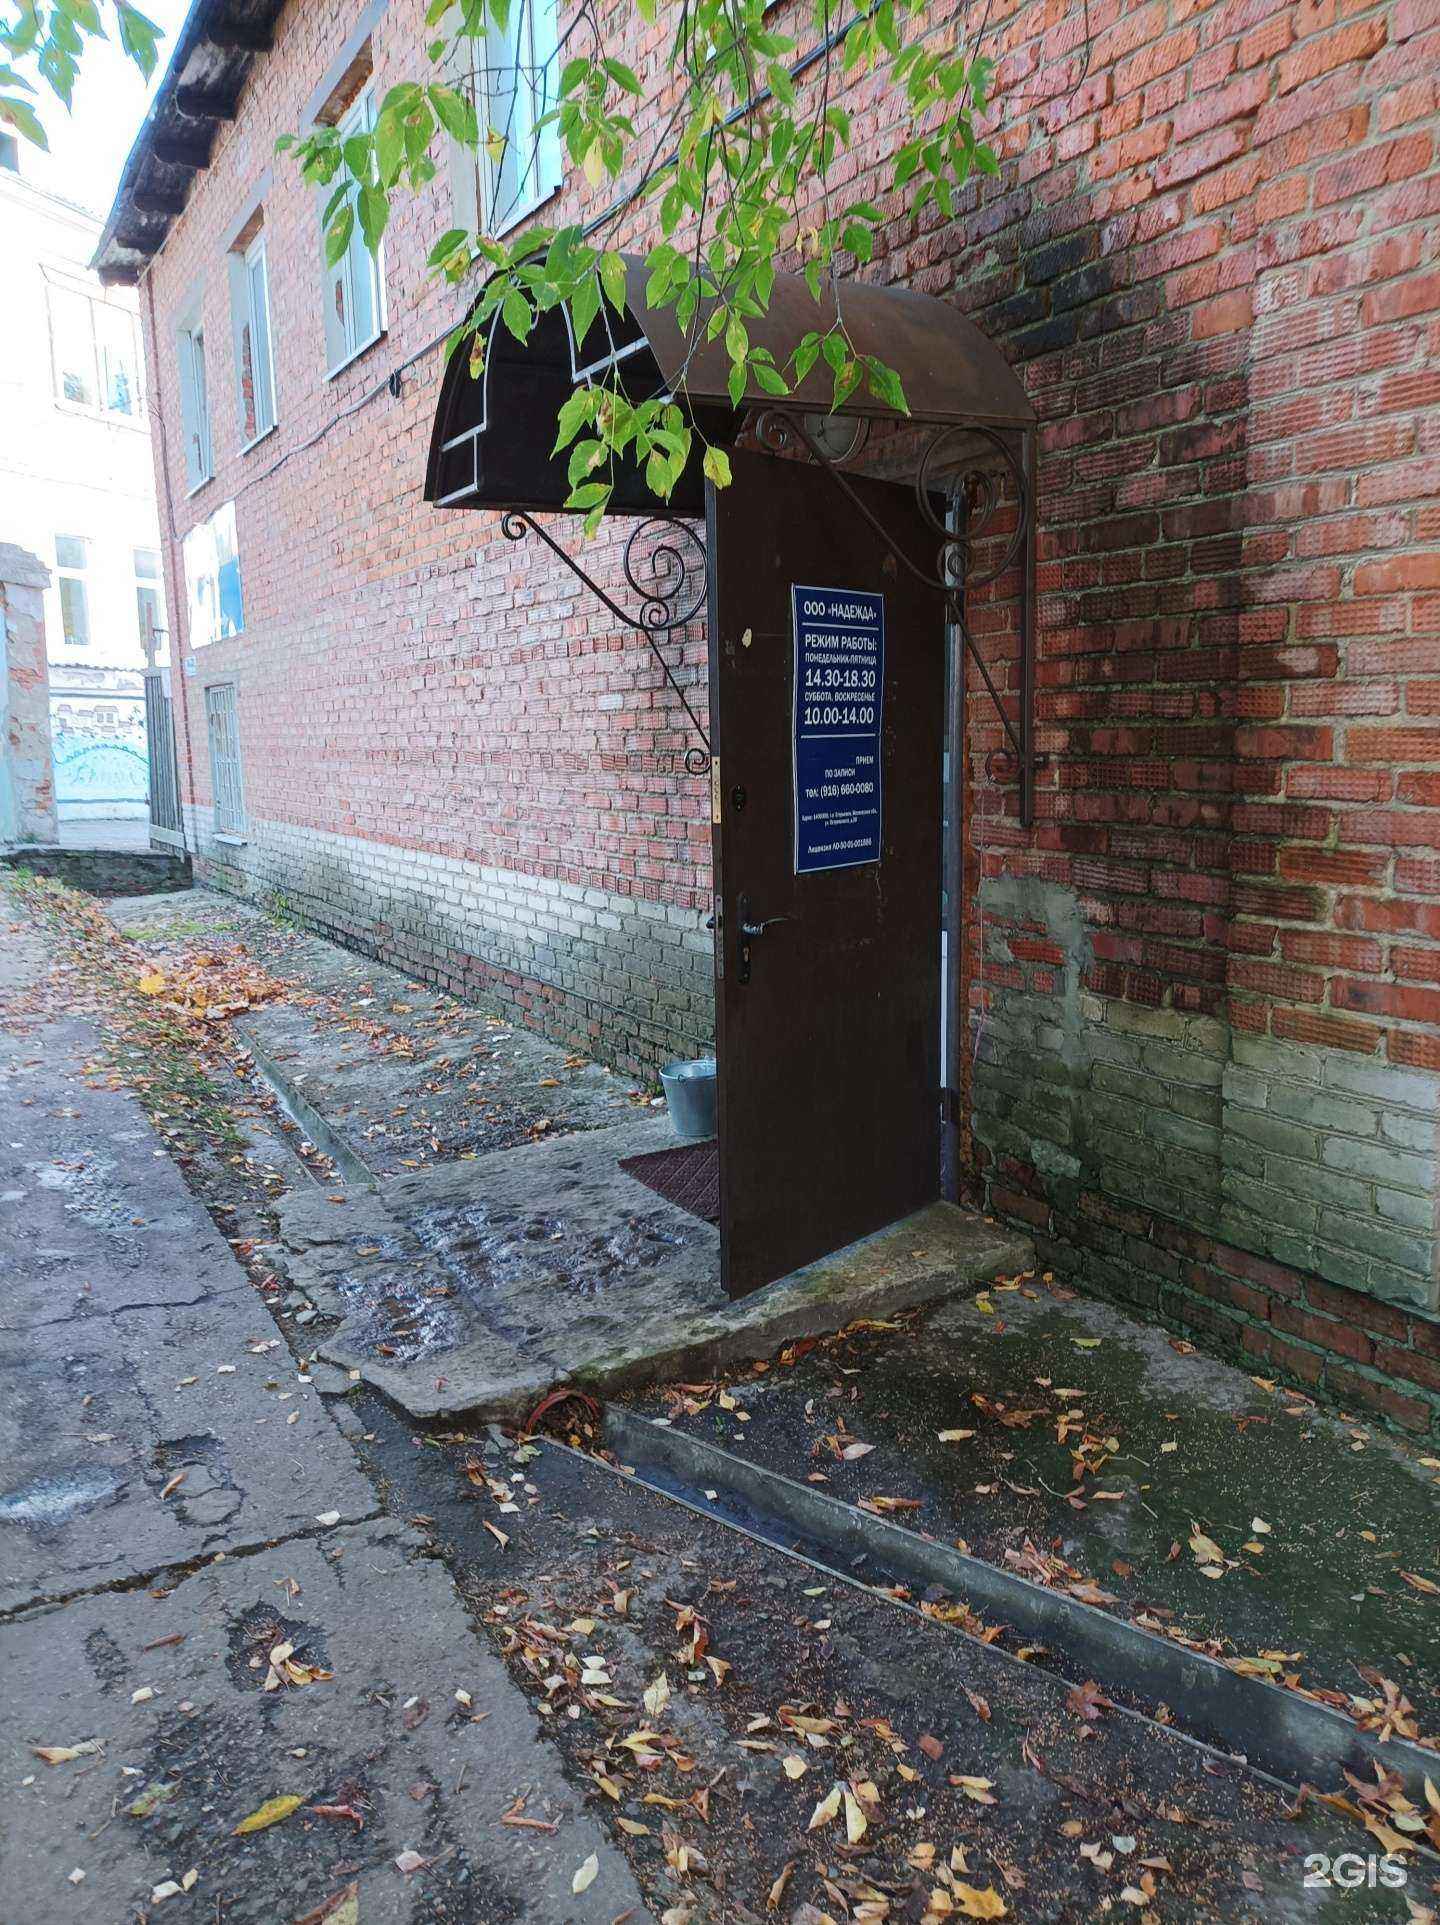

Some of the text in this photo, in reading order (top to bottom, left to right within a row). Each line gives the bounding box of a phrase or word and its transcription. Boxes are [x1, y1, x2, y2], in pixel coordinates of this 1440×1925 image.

[804, 601, 825, 616] ООО
[805, 634, 877, 651] РЕЖИМ РАБОТЫ:
[805, 652, 877, 666] ПОНЕДЕЛЬНИК-ПЯТНИЦА
[805, 668, 876, 688] 14.30-18.30
[835, 691, 875, 702] ВОСКРЕСЕНЬЕ
[804, 707, 874, 725] 10.00-14.00
[855, 755, 874, 765] ПРИЕМ
[824, 768, 856, 778] ПО ЗАПИСИ
